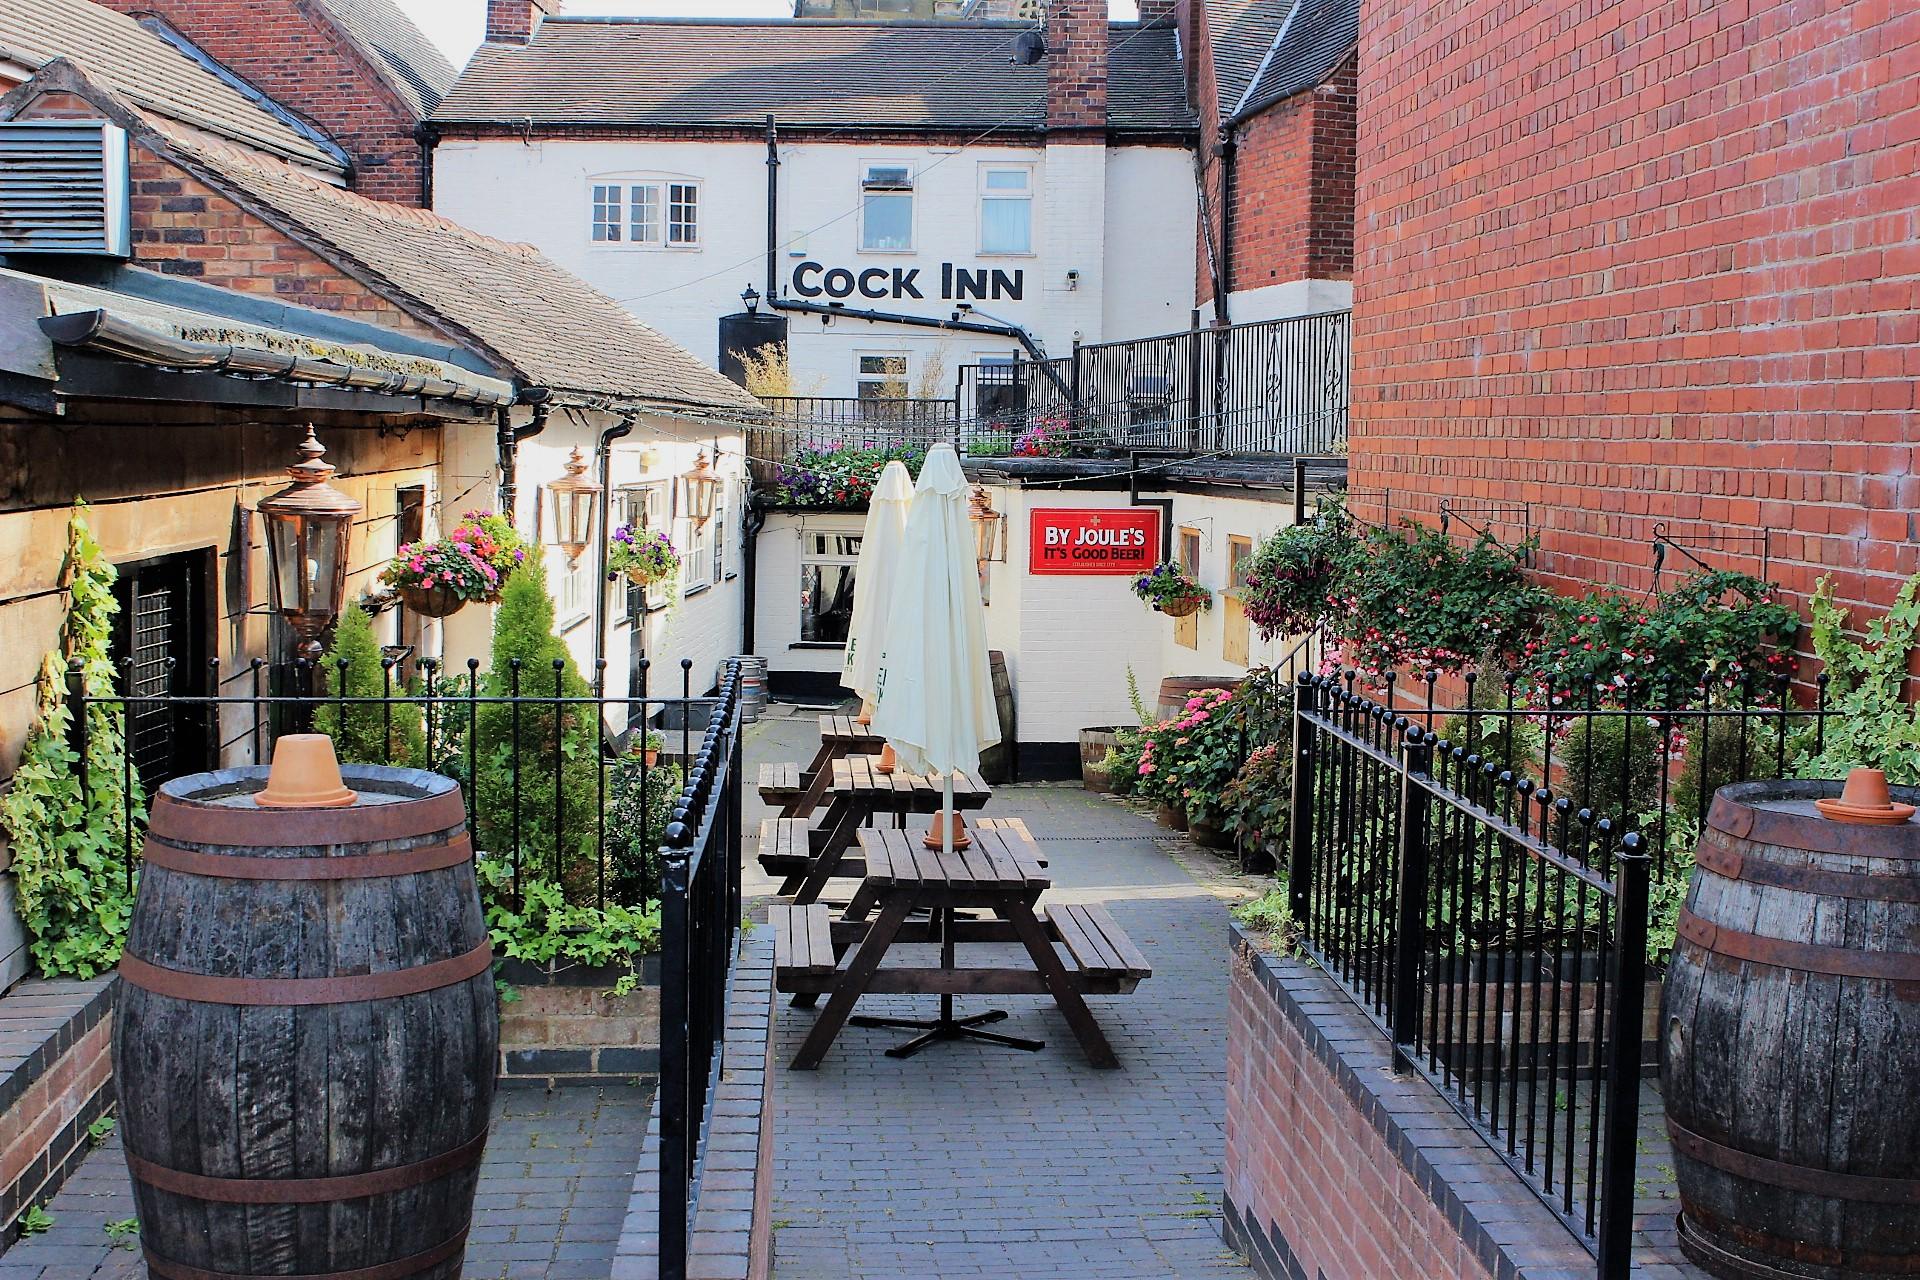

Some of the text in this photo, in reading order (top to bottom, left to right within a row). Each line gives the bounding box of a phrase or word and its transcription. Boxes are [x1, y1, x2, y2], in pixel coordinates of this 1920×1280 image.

[792, 261, 1024, 301] COCK INN
[1044, 526, 1145, 546] BY JOULE'S
[1044, 547, 1145, 560] IT'S GOOD BEER!
